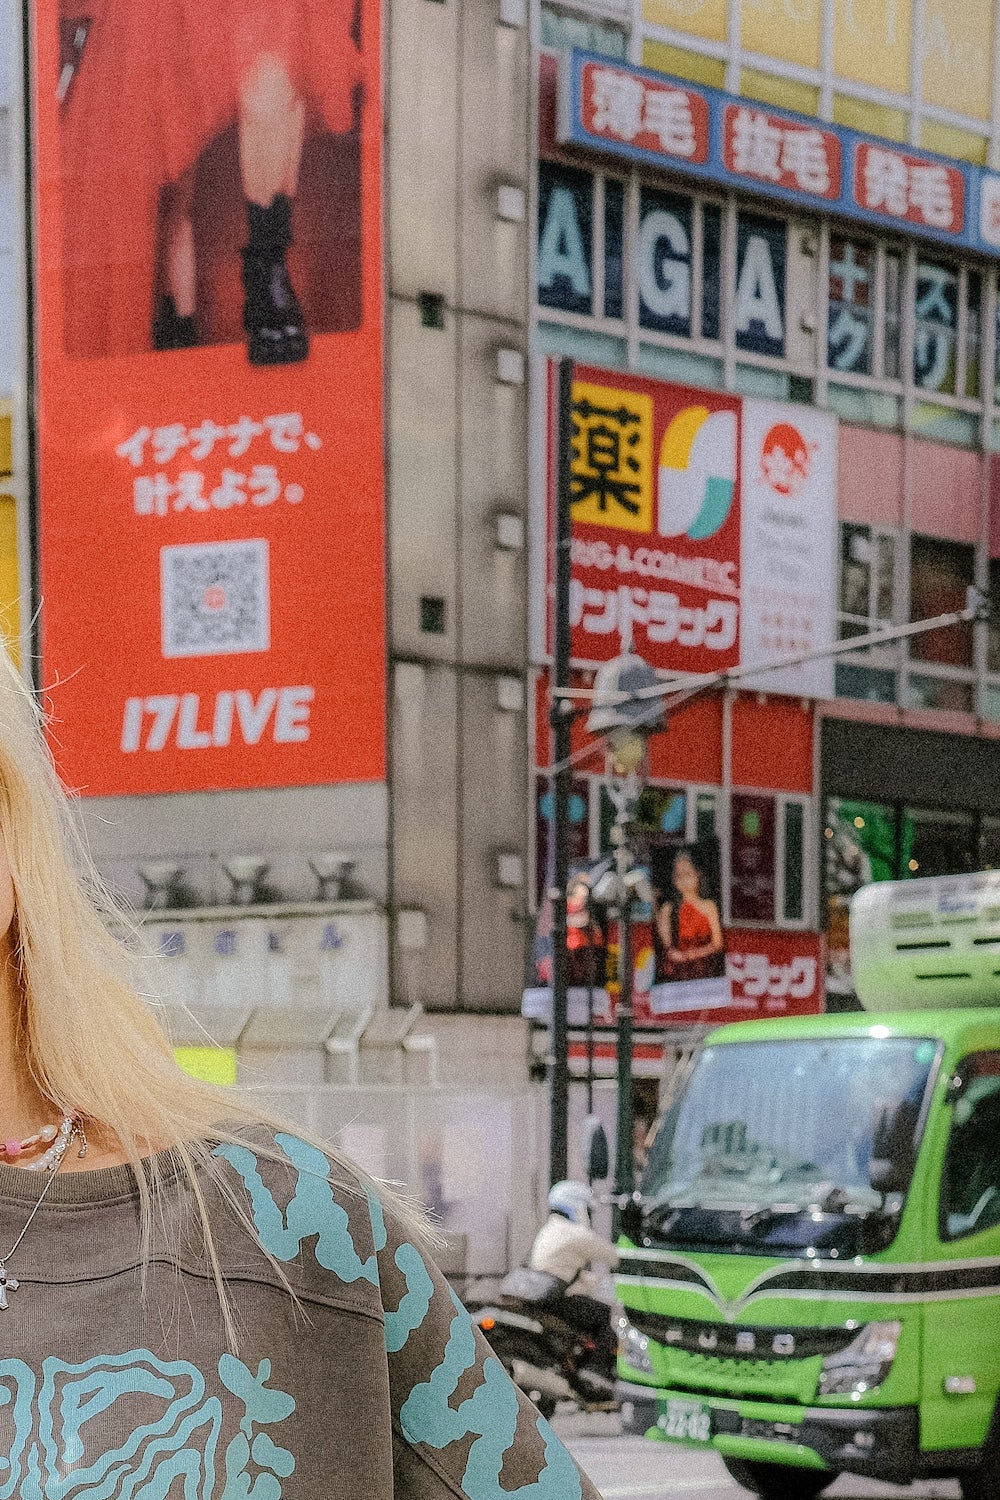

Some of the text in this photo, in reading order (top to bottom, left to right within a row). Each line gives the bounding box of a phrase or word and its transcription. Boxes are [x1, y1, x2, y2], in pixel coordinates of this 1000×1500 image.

[539, 187, 782, 340] AGA
[115, 411, 323, 467] イチナナで、
[571, 398, 642, 515] 薬
[132, 464, 305, 516] 叶えよう。
[120, 686, 315, 754] 17LIVE
